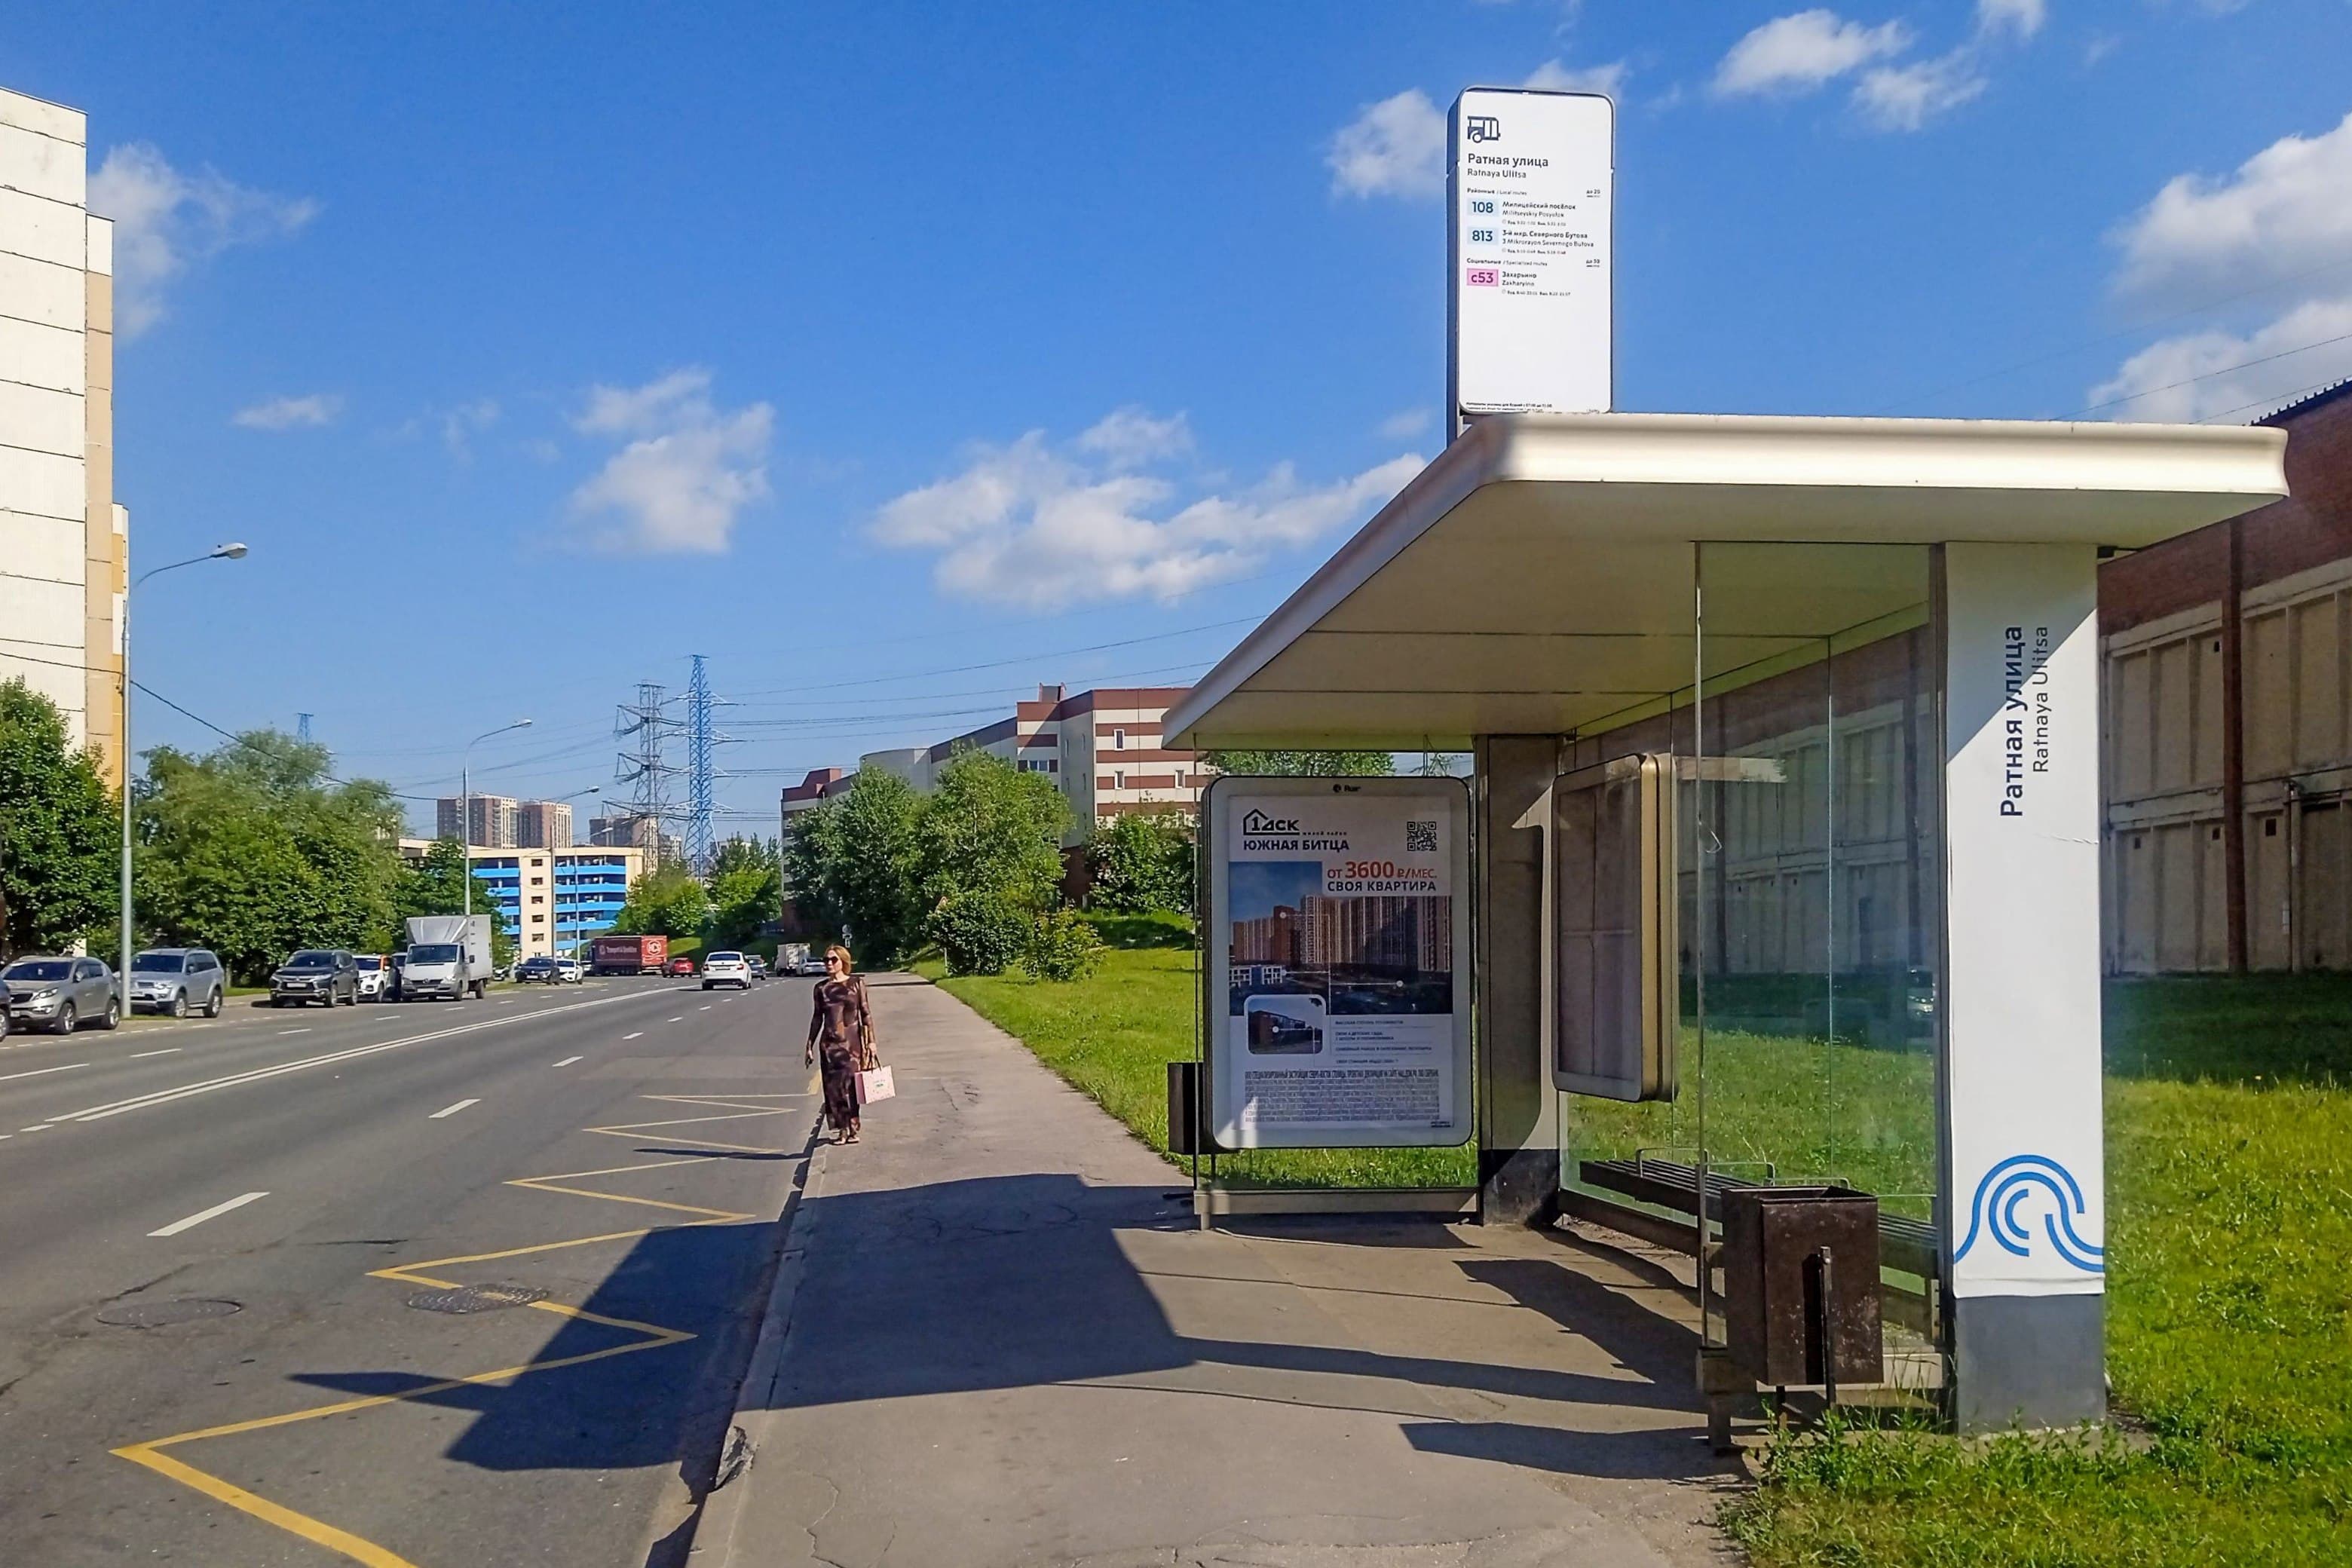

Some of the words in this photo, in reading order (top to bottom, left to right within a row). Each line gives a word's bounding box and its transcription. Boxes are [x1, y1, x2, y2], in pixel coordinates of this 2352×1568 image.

[1468, 153, 1509, 166] Ратная
[1512, 156, 1548, 168] улица
[1467, 168, 1500, 178] Ratnaya
[1502, 169, 1527, 179] Ulitsa
[1472, 201, 1494, 213] 108
[1502, 201, 1548, 209] Милицейский
[1472, 230, 1493, 242] 813
[1530, 231, 1564, 239] Северного
[1566, 232, 1588, 240] Бутова
[1502, 271, 1537, 280] Захарьино
[2032, 626, 2048, 685] Ulitsa
[2005, 626, 2028, 711] улица
[2032, 692, 2052, 772] Ratnaya
[2000, 720, 2023, 816] Ратная
[1244, 840, 1298, 850] ЮЖНАЯ
[1303, 840, 1350, 853] БИТЦА
[1328, 868, 1342, 878] ОТ
[1345, 861, 1394, 878] 3600
[1328, 881, 1363, 891] СВОЯ
[1367, 881, 1436, 891] КВАРТИРА
